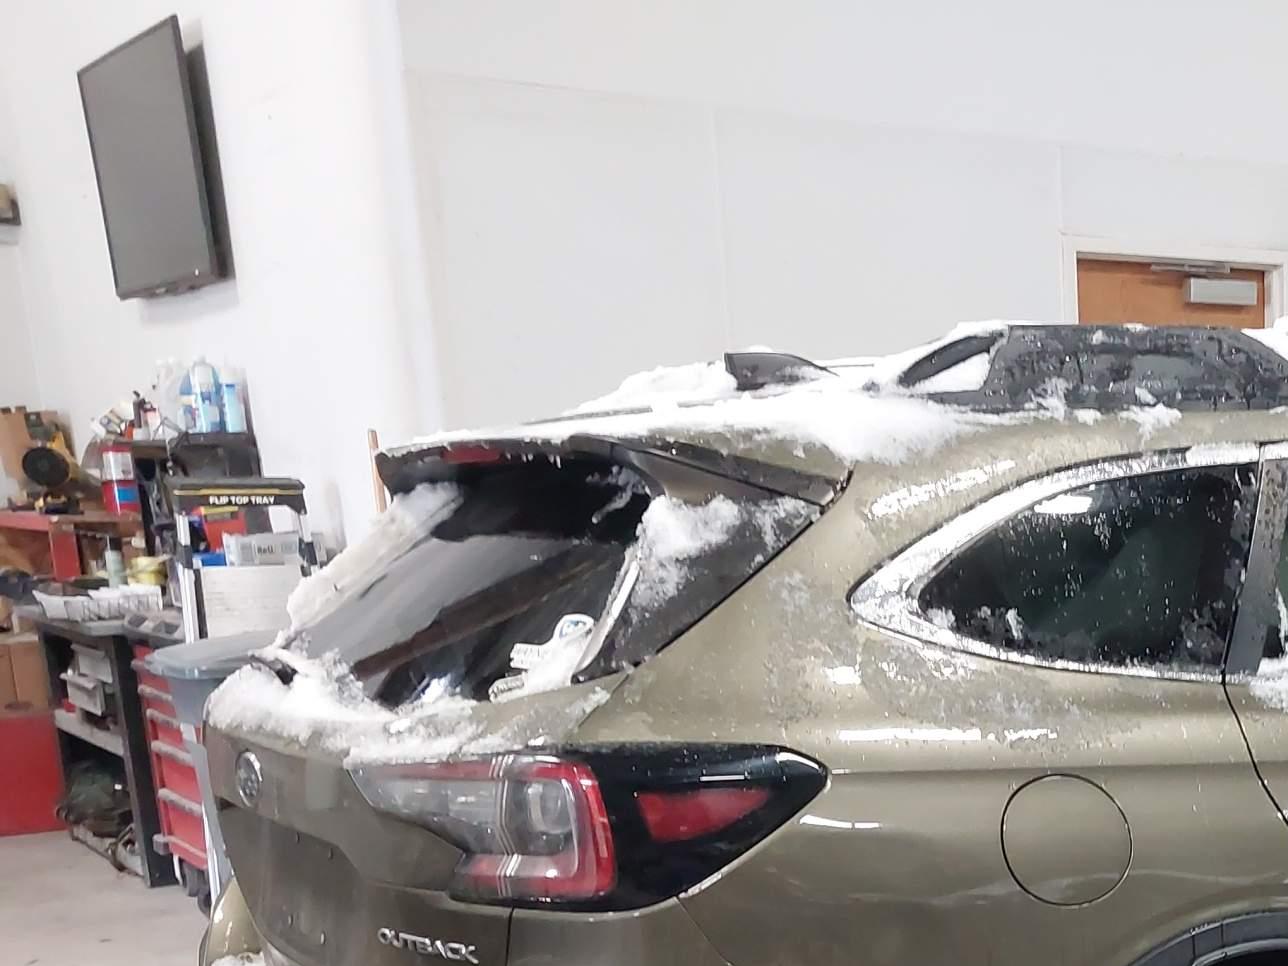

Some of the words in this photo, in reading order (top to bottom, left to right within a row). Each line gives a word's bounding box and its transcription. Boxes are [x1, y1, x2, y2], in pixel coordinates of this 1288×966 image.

[209, 495, 229, 505] FLIP
[230, 495, 249, 505] TOP
[250, 495, 275, 505] TRAY
[377, 927, 480, 965] OUTBACK
